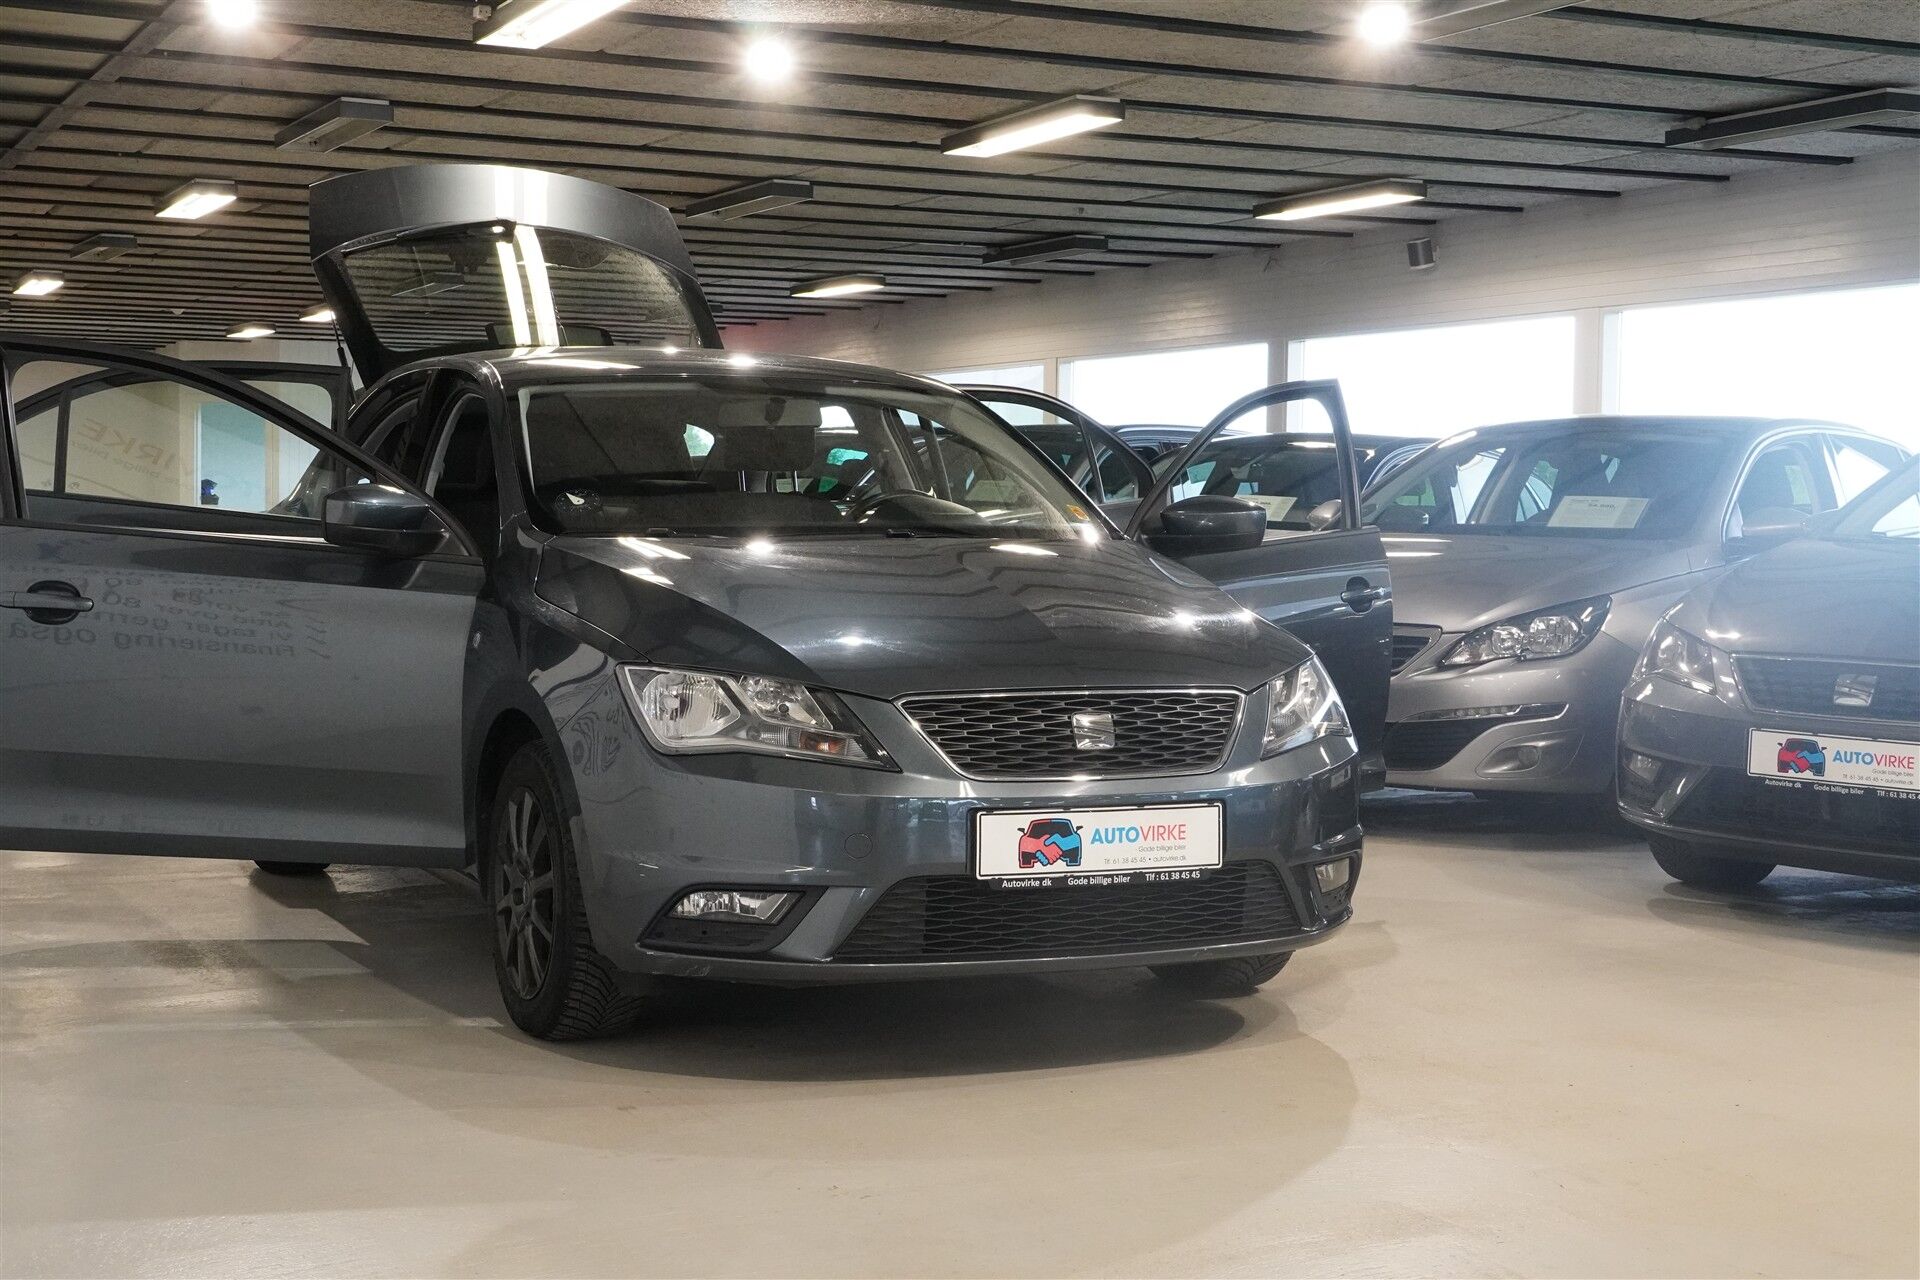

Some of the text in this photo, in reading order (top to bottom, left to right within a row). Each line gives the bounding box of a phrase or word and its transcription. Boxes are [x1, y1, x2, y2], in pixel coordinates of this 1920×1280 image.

[1832, 749, 1915, 770] AUTOVIRKE
[1764, 778, 1793, 788] Autovirke
[1793, 781, 1802, 789] dk
[1813, 783, 1830, 792] Gode
[1090, 824, 1187, 845] AUTOVIRKE
[1002, 878, 1040, 888] Autovirke
[1041, 878, 1052, 887] dk
[1067, 876, 1088, 886] Gode
[1113, 874, 1131, 884] biler
[1160, 871, 1169, 881] 61
[1170, 871, 1180, 881] 38
[1181, 870, 1190, 880] 45
[1191, 869, 1201, 879] 45
